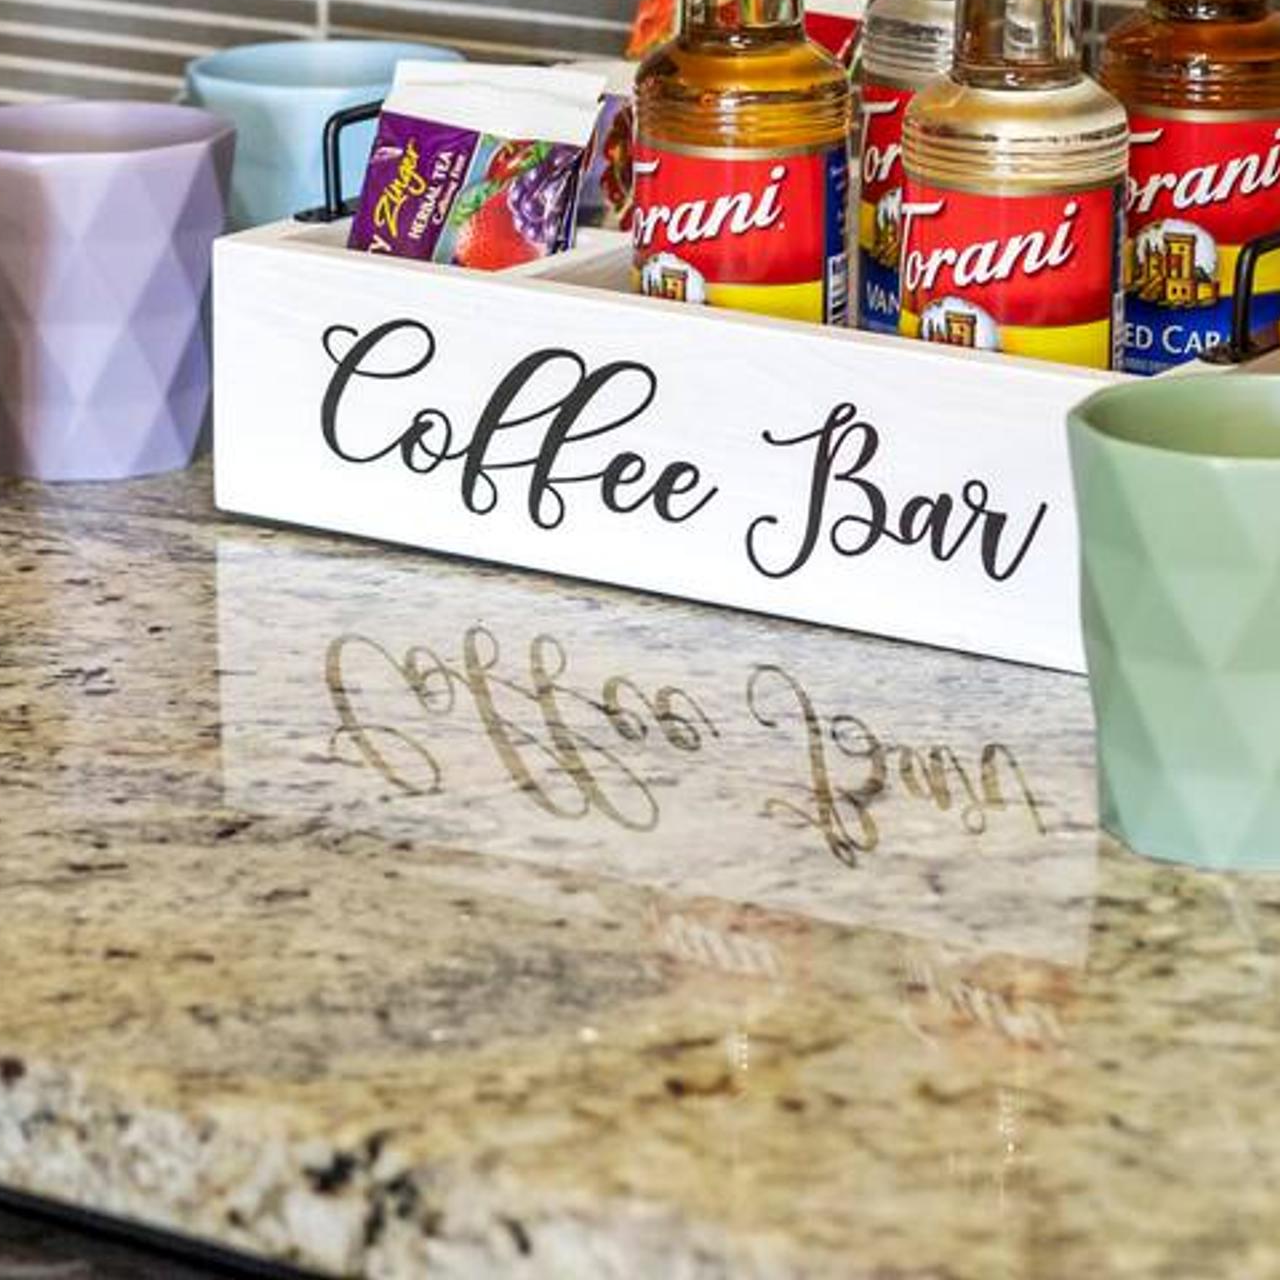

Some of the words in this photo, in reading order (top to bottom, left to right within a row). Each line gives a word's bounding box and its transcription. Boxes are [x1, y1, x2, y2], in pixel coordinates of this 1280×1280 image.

[373, 136, 427, 238] Zinger
[901, 199, 1078, 291] Torani
[321, 318, 718, 530] Coffee
[746, 402, 1048, 581] Bar
